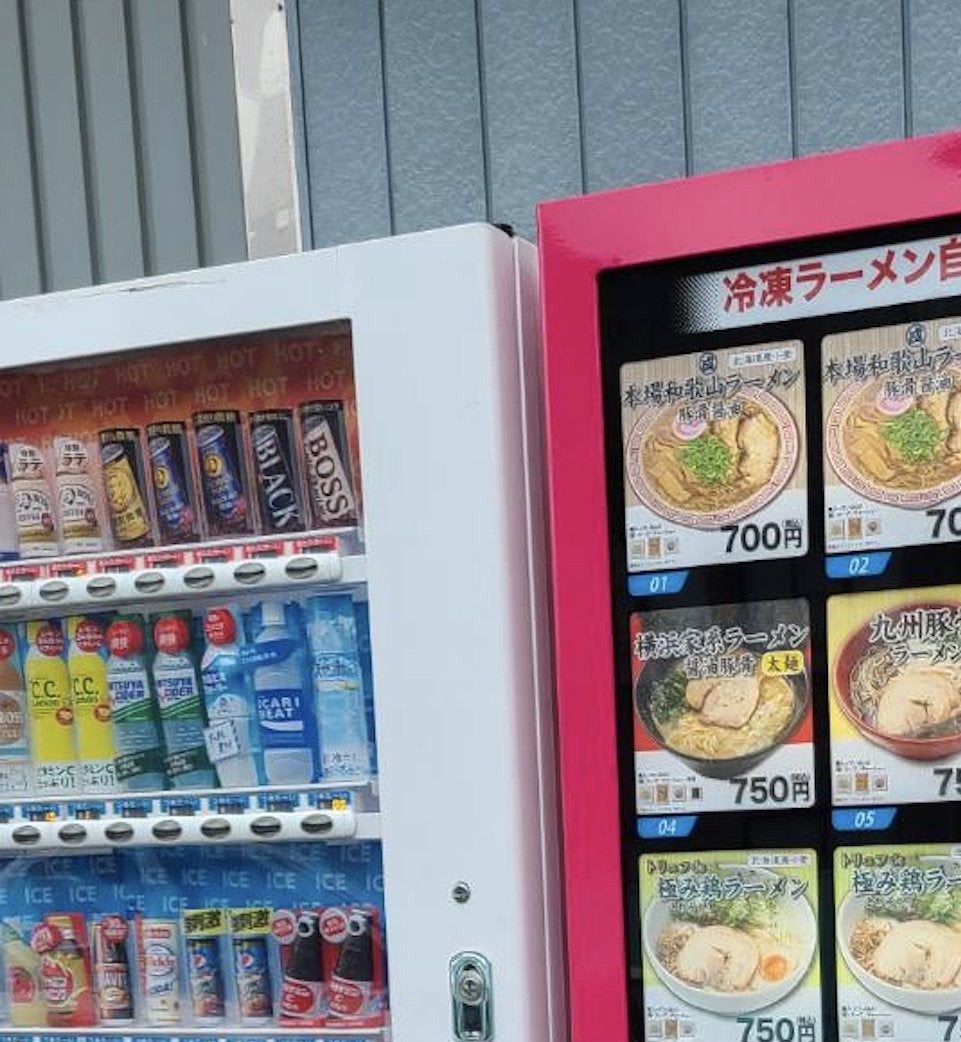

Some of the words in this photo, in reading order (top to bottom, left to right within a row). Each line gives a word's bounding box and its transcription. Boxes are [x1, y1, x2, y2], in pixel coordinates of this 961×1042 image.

[309, 432, 350, 515] BOSS
[254, 438, 300, 528] BLACK
[721, 522, 803, 553] 700円
[849, 557, 871, 575] 02
[649, 576, 668, 593] 01
[768, 656, 800, 673] 太麺
[729, 776, 810, 805] 750円
[854, 811, 875, 827] 05
[658, 821, 676, 836] 04
[267, 873, 297, 890] ICE
[316, 874, 347, 891] ICE
[659, 875, 809, 900] 極み鶏ラーメン
